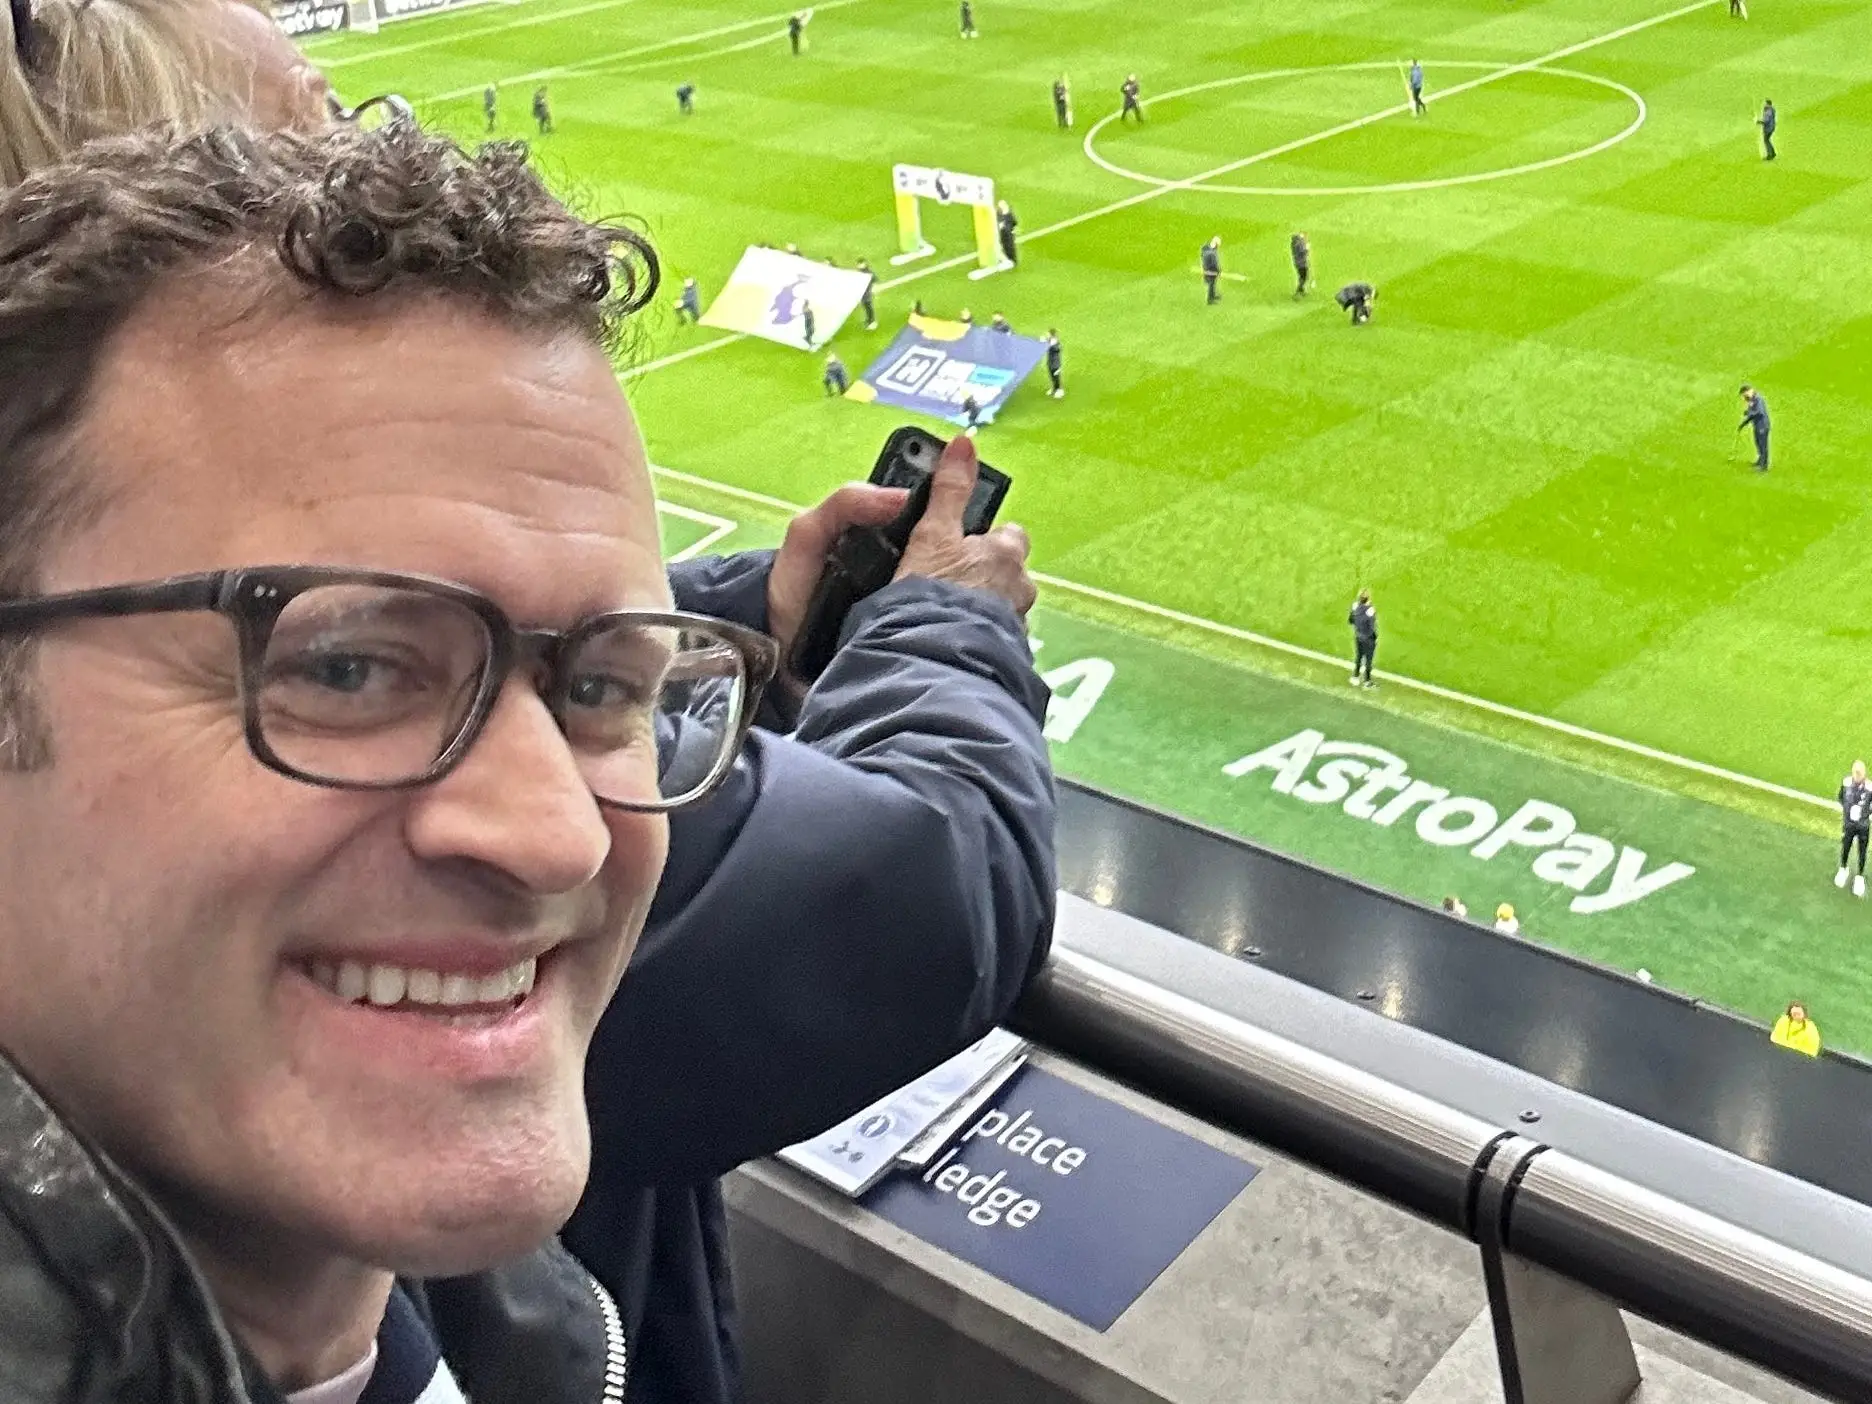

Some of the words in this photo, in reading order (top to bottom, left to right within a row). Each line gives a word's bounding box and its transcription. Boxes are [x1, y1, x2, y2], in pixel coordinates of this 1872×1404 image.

[1222, 729, 1695, 914] AstroPay
[961, 1109, 1087, 1176] place
[923, 1148, 1041, 1228] ledge
